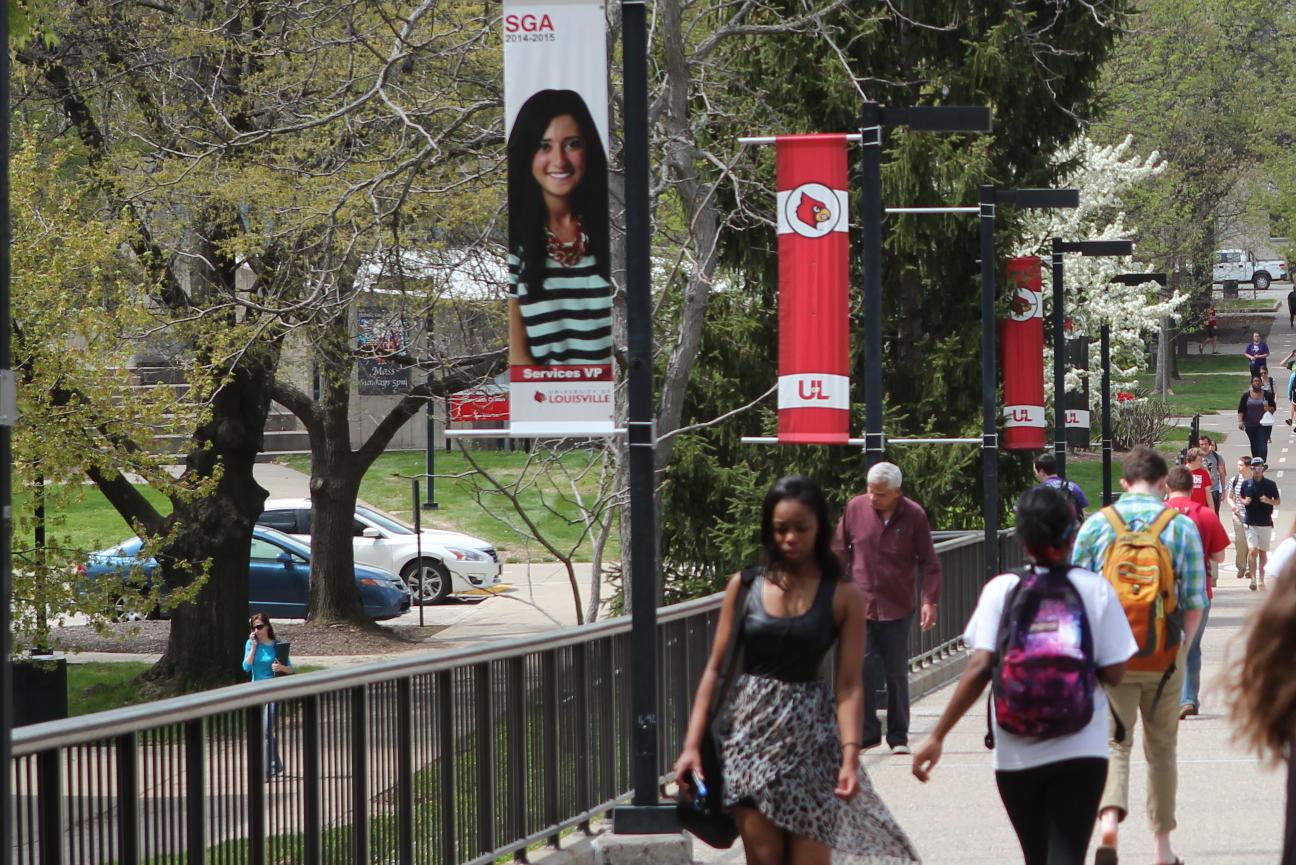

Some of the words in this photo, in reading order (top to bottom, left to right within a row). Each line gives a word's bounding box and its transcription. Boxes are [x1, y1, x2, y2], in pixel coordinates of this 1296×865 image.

[505, 14, 554, 33] SGA
[505, 33, 556, 43] 2014-2015
[369, 367, 395, 377] Mass
[522, 368, 581, 379] Services
[583, 367, 603, 378] VP
[548, 394, 610, 404] LOUISVILLE
